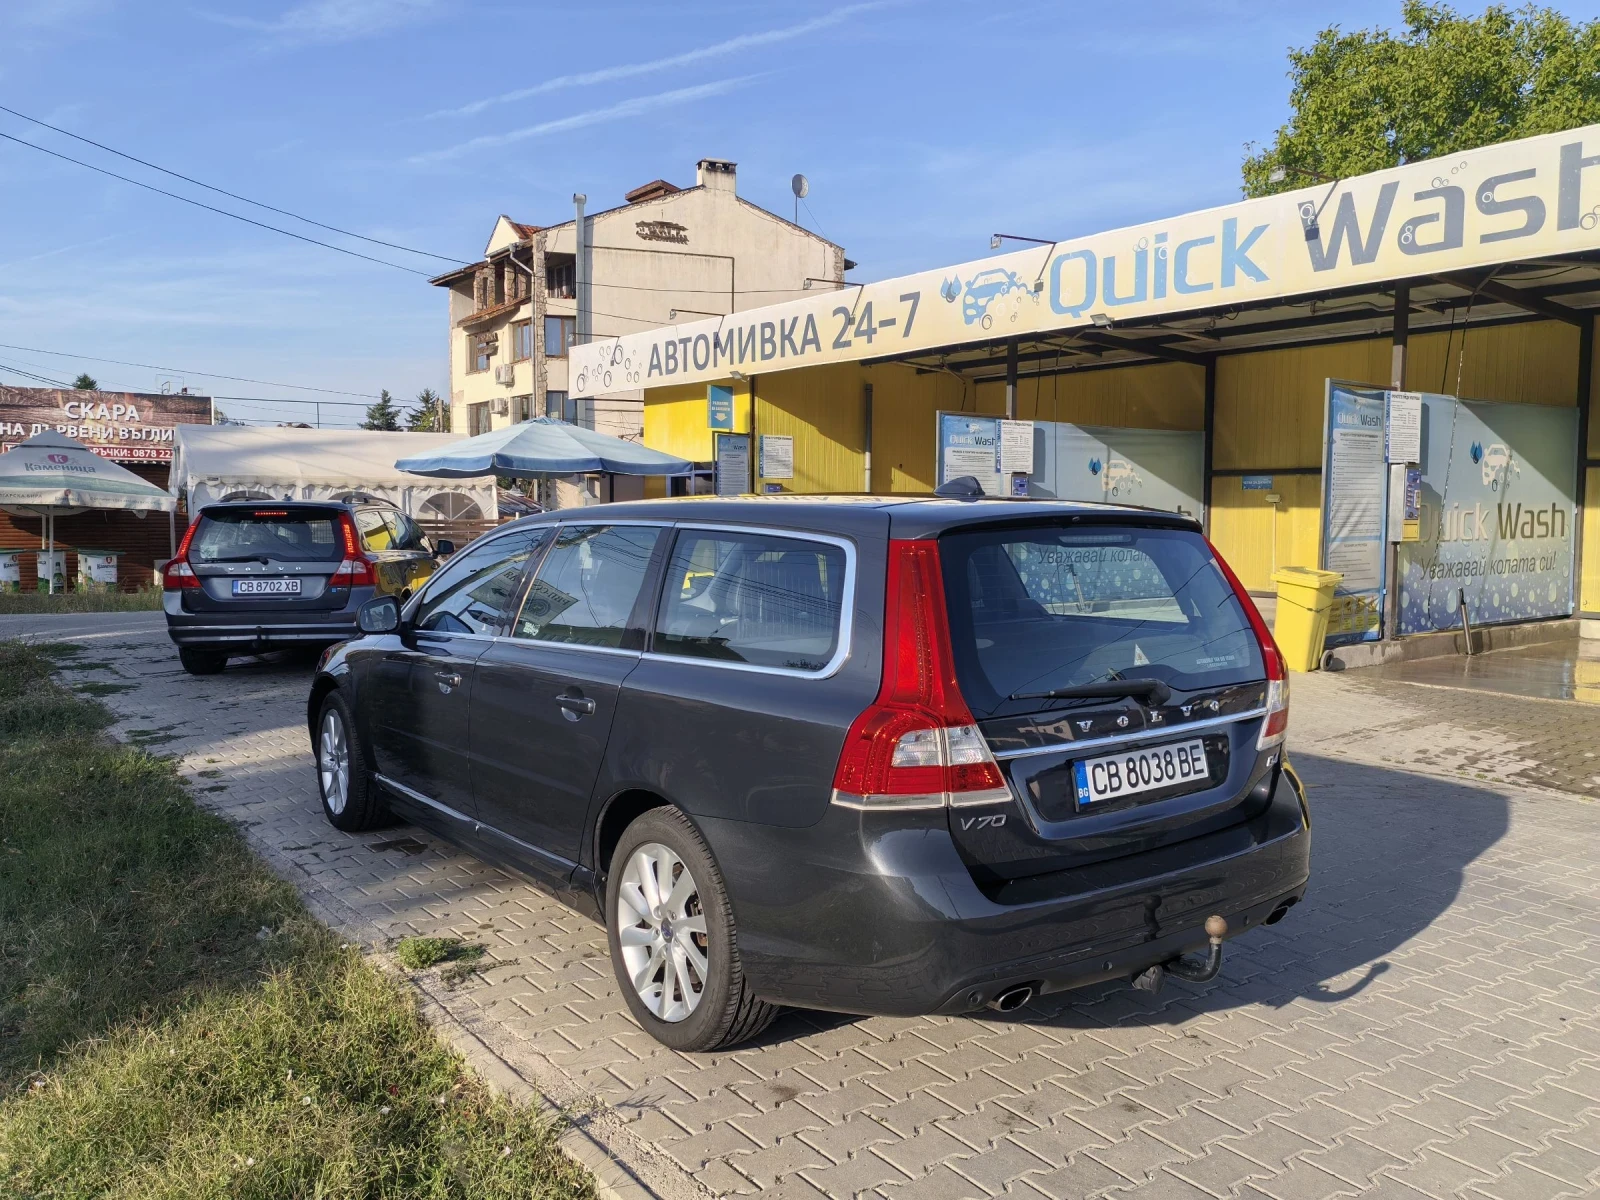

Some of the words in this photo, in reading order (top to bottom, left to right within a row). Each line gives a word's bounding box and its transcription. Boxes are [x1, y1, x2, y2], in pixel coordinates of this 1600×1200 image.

[1050, 217, 1270, 319] Quick
[647, 313, 822, 378] АВТОМИВКА
[832, 291, 921, 349] 24-7
[64, 401, 141, 422] СКАРА
[1360, 414, 1382, 427] Wash
[0, 422, 25, 436] НА
[120, 427, 175, 441] ВЪГЛИ
[132, 449, 157, 458] 0878
[24, 462, 97, 473] Каменица
[1497, 502, 1565, 540] Wash
[1420, 556, 1487, 581] Уважавай
[1489, 555, 1536, 576] колата
[1539, 551, 1557, 571] си!
[240, 581, 254, 592] CB
[256, 581, 283, 592] 8702
[284, 581, 299, 592] XB
[1077, 700, 1220, 733] VOLVO
[1091, 760, 1123, 796] CB
[1125, 750, 1177, 789] 8038
[1177, 744, 1205, 778] BE
[1078, 787, 1089, 799] BG
[960, 814, 1007, 830] V70
